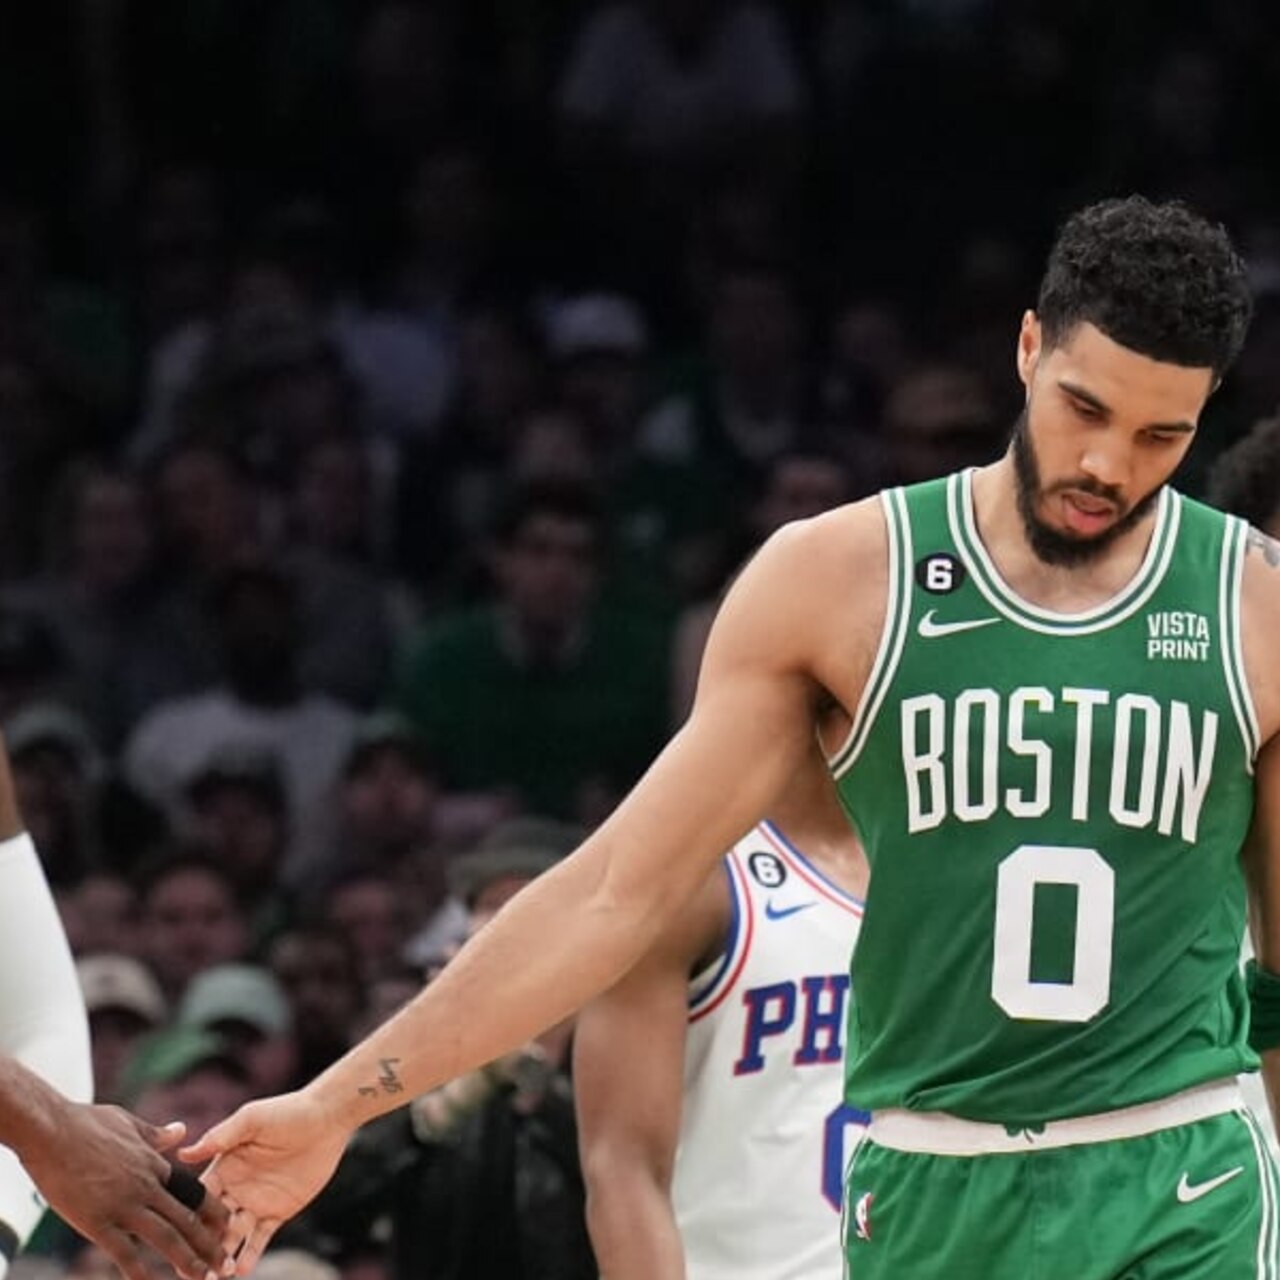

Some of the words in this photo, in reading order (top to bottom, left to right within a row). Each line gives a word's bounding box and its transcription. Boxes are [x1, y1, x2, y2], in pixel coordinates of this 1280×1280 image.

[926, 557, 953, 591] 6
[1147, 611, 1210, 641] VISTA
[1147, 639, 1211, 661] PRINT
[900, 685, 1219, 844] BOSTON
[751, 853, 784, 886] 6
[991, 845, 1116, 1022] 0
